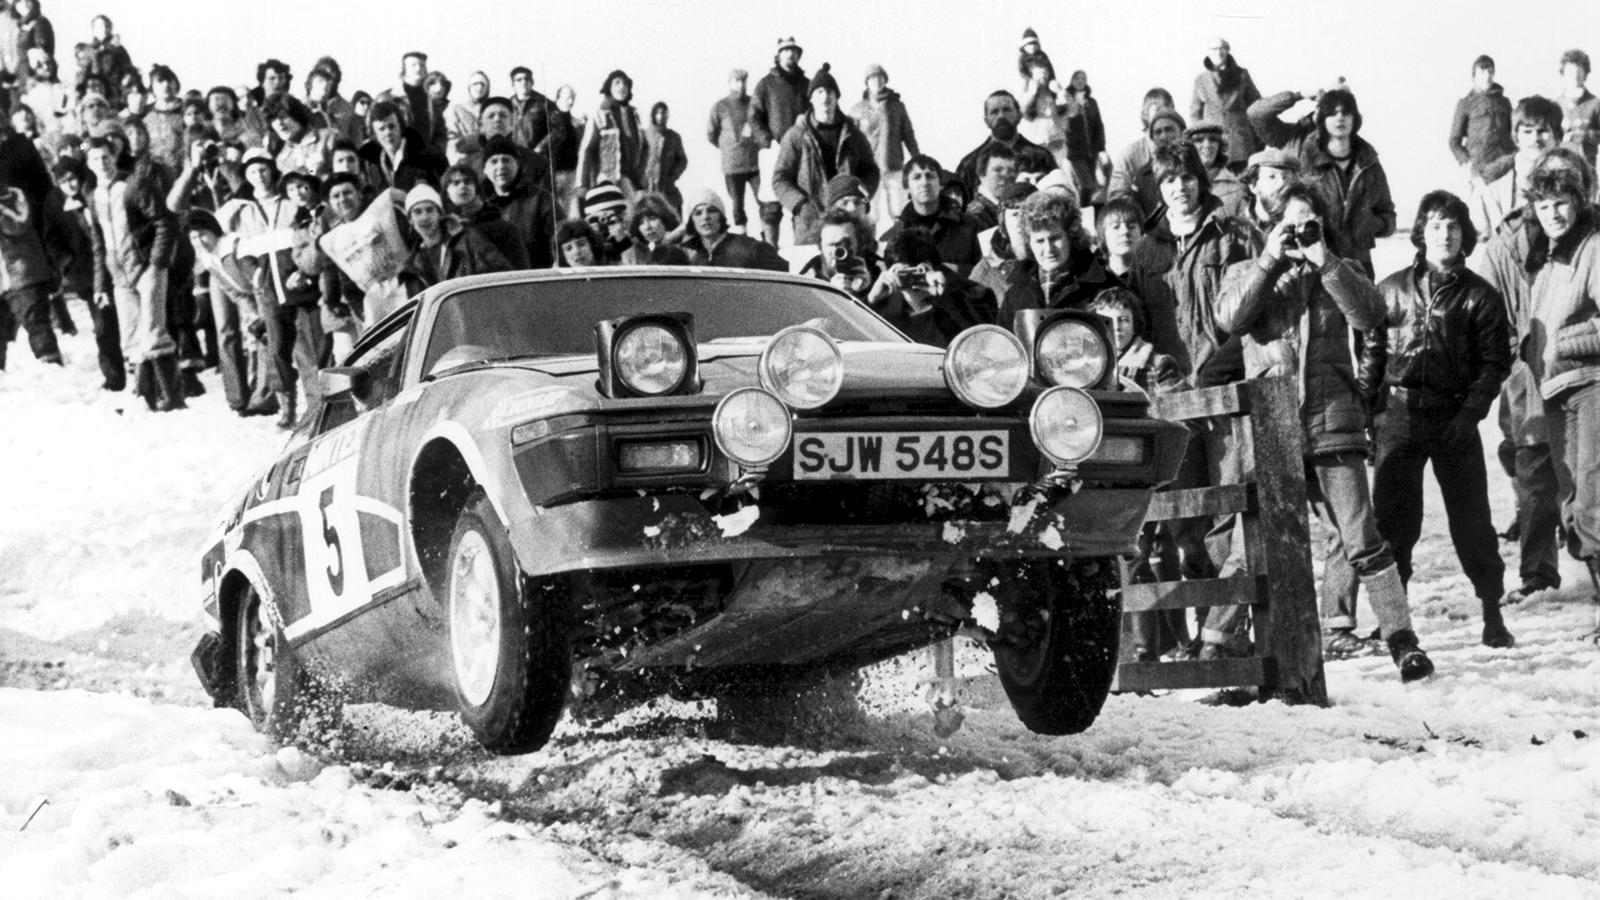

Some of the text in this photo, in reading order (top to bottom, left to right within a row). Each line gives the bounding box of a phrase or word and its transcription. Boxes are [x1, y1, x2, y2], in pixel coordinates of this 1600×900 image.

[800, 435, 1004, 473] SJW 548S
[320, 485, 344, 597] 5
